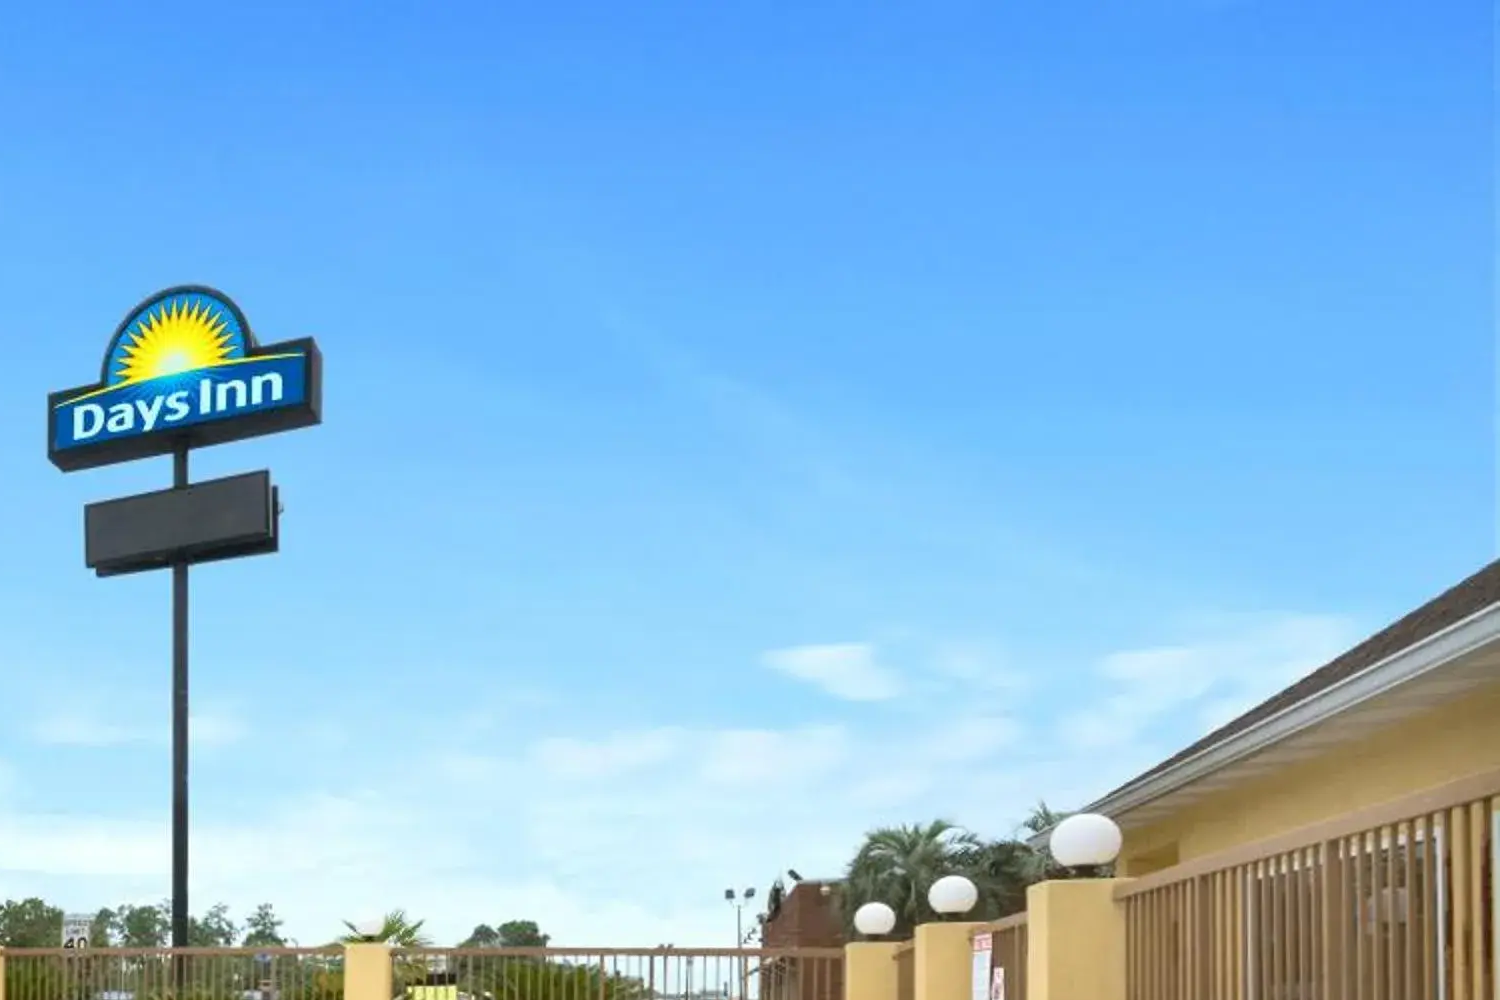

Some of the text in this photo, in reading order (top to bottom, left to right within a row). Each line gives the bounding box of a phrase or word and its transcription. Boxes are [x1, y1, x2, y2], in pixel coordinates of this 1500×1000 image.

[72, 370, 283, 441] Days Inn
[63, 936, 88, 949] 40
